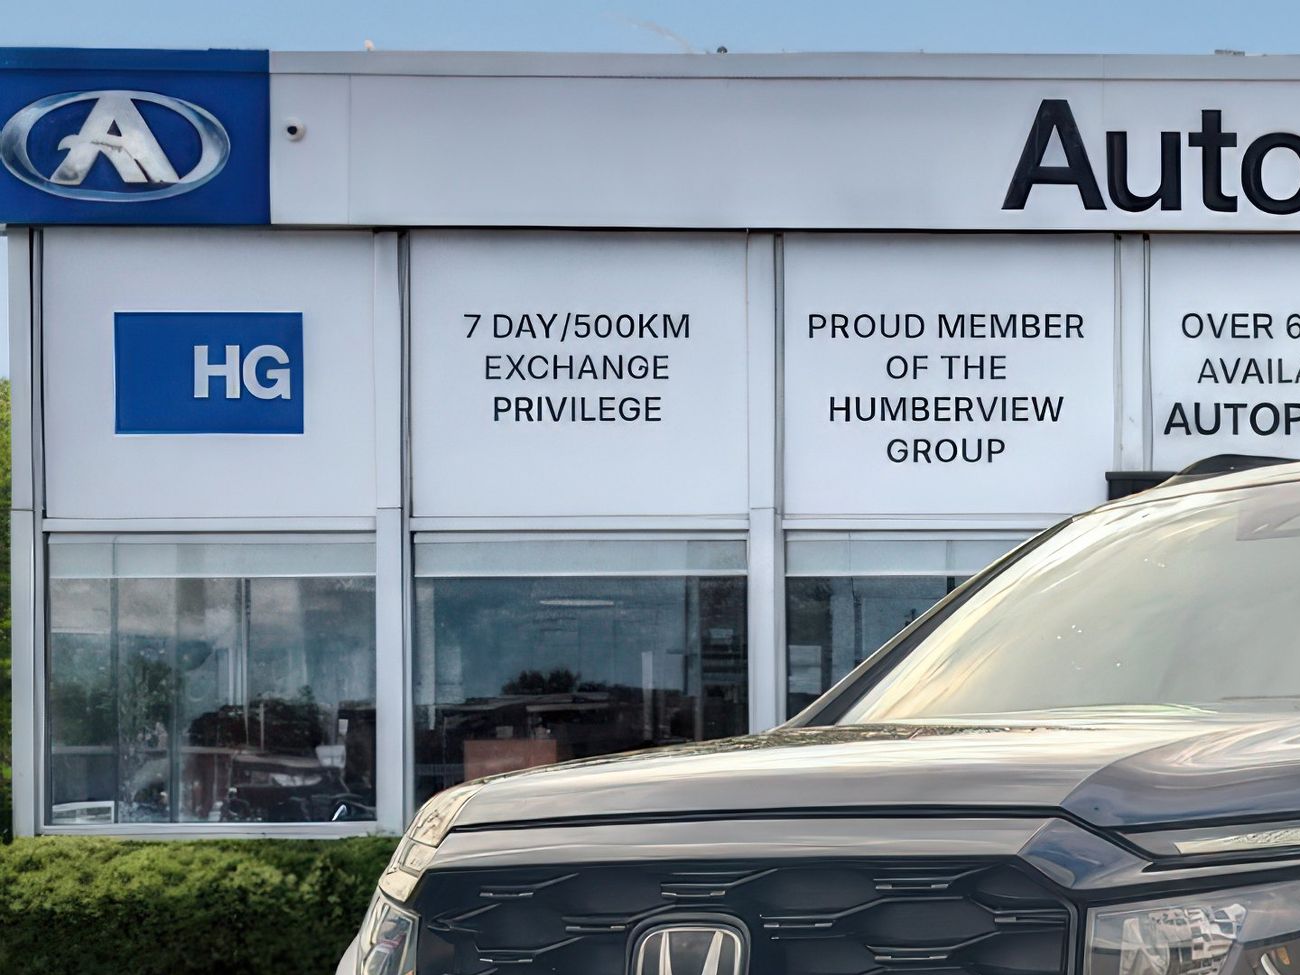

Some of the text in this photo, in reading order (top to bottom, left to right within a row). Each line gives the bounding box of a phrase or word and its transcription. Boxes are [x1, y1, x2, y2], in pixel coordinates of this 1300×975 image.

[463, 312, 690, 343] 7 DAY/500KM
[808, 313, 1085, 339] PROUD MEMBER
[1181, 313, 1274, 340] OVER
[193, 344, 291, 400] HG
[485, 354, 669, 381] EXCHANGE
[886, 354, 1007, 380] OF THE
[493, 396, 662, 423] PRIVILEGE
[829, 396, 1064, 423] HUMBERVIEW
[886, 438, 1006, 464] GROUP
